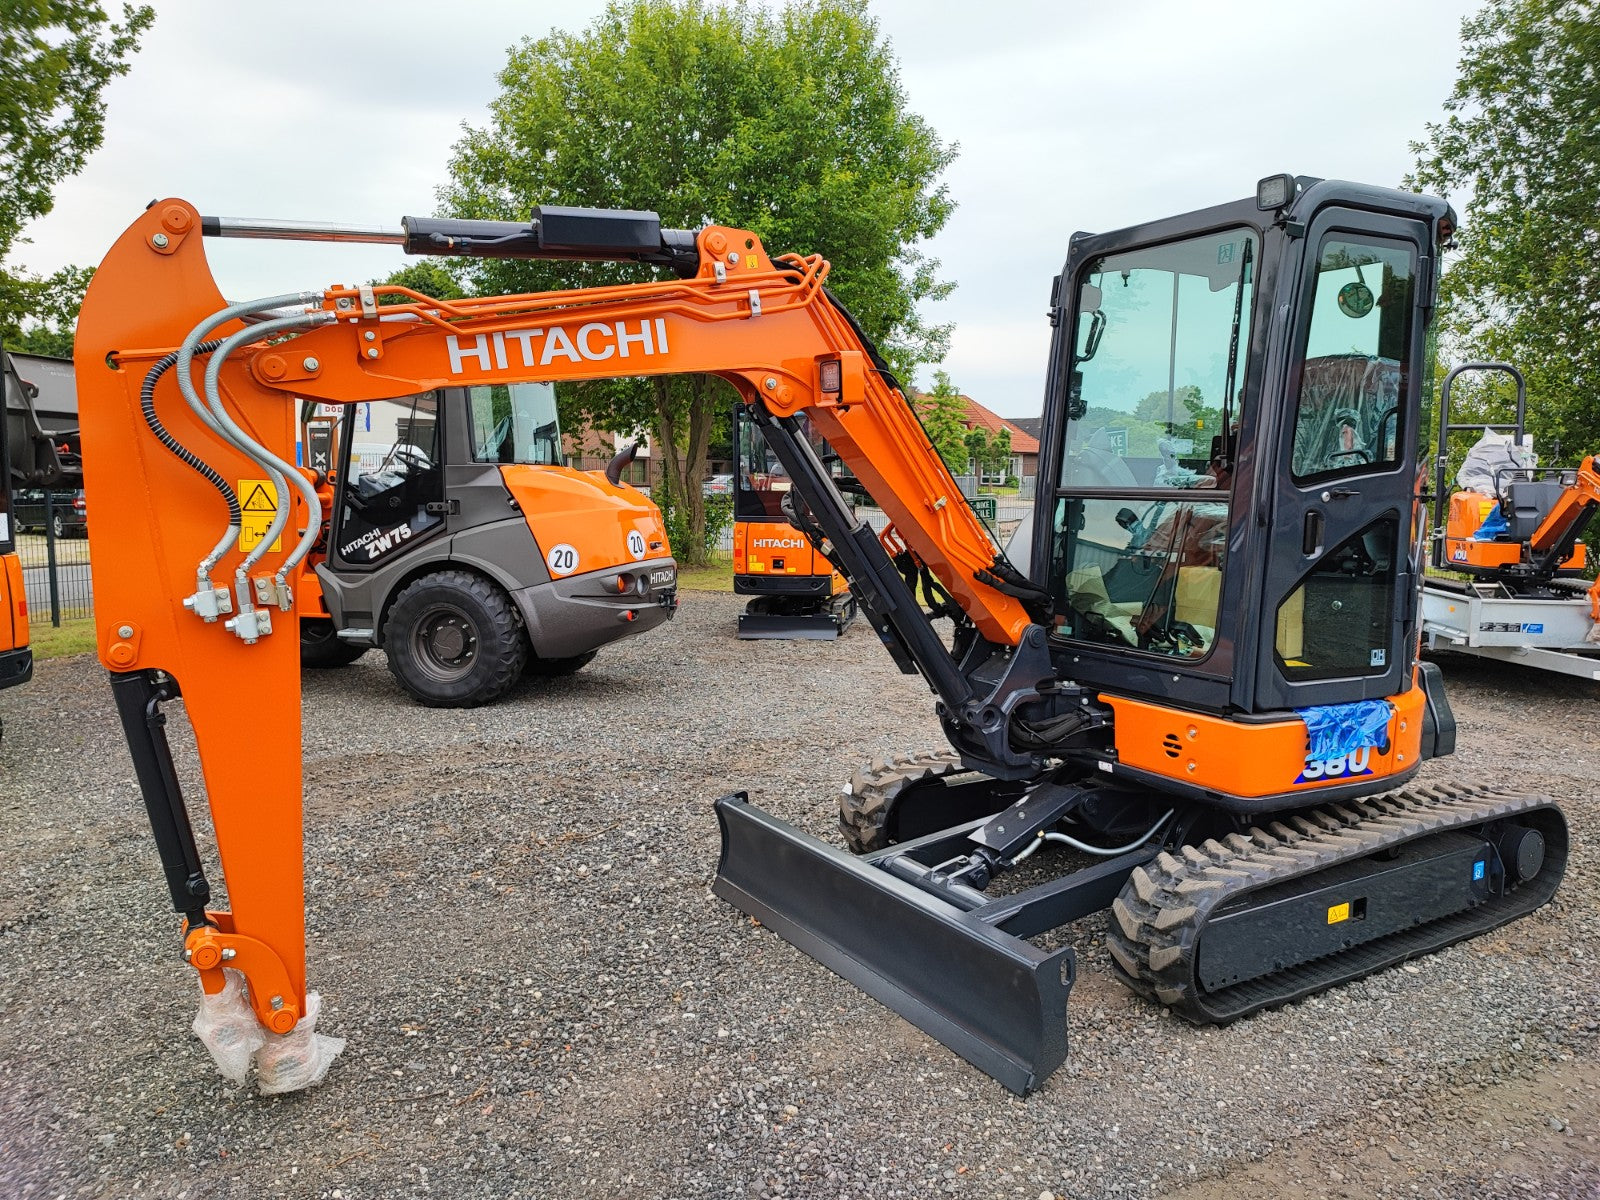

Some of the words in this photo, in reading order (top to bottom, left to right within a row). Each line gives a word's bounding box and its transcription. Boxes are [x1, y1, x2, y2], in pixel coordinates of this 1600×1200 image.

[446, 318, 669, 374] HITACHI
[341, 527, 381, 556] HITACHI
[364, 523, 412, 559] ZW75
[631, 536, 643, 554] 20
[753, 538, 805, 549] HITACHI
[553, 549, 574, 568] 20
[650, 569, 675, 585] HITACHI
